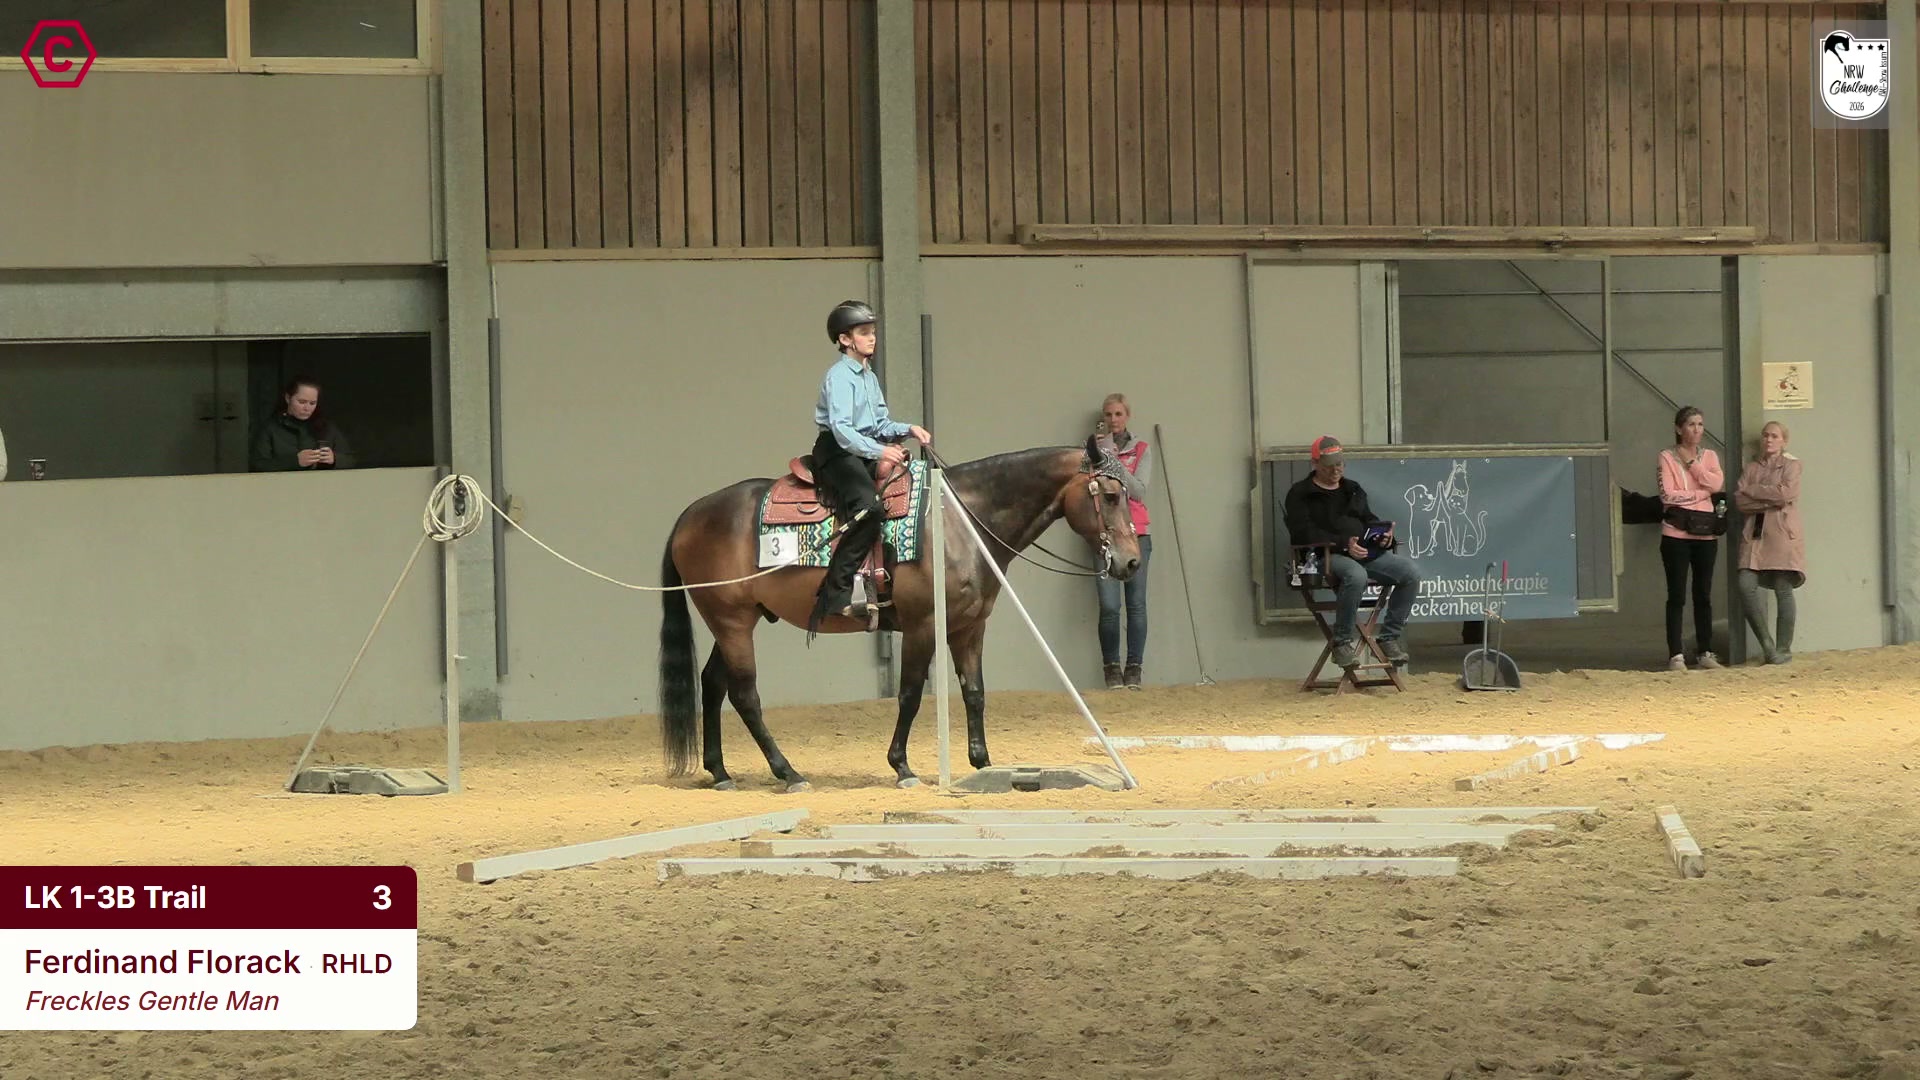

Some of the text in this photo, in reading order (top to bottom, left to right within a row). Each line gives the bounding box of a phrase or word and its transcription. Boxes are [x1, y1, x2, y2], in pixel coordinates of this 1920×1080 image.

[771, 537, 781, 557] 3
[1418, 572, 1549, 598] rphysiotherapie
[1410, 597, 1507, 617] eckenheuer
